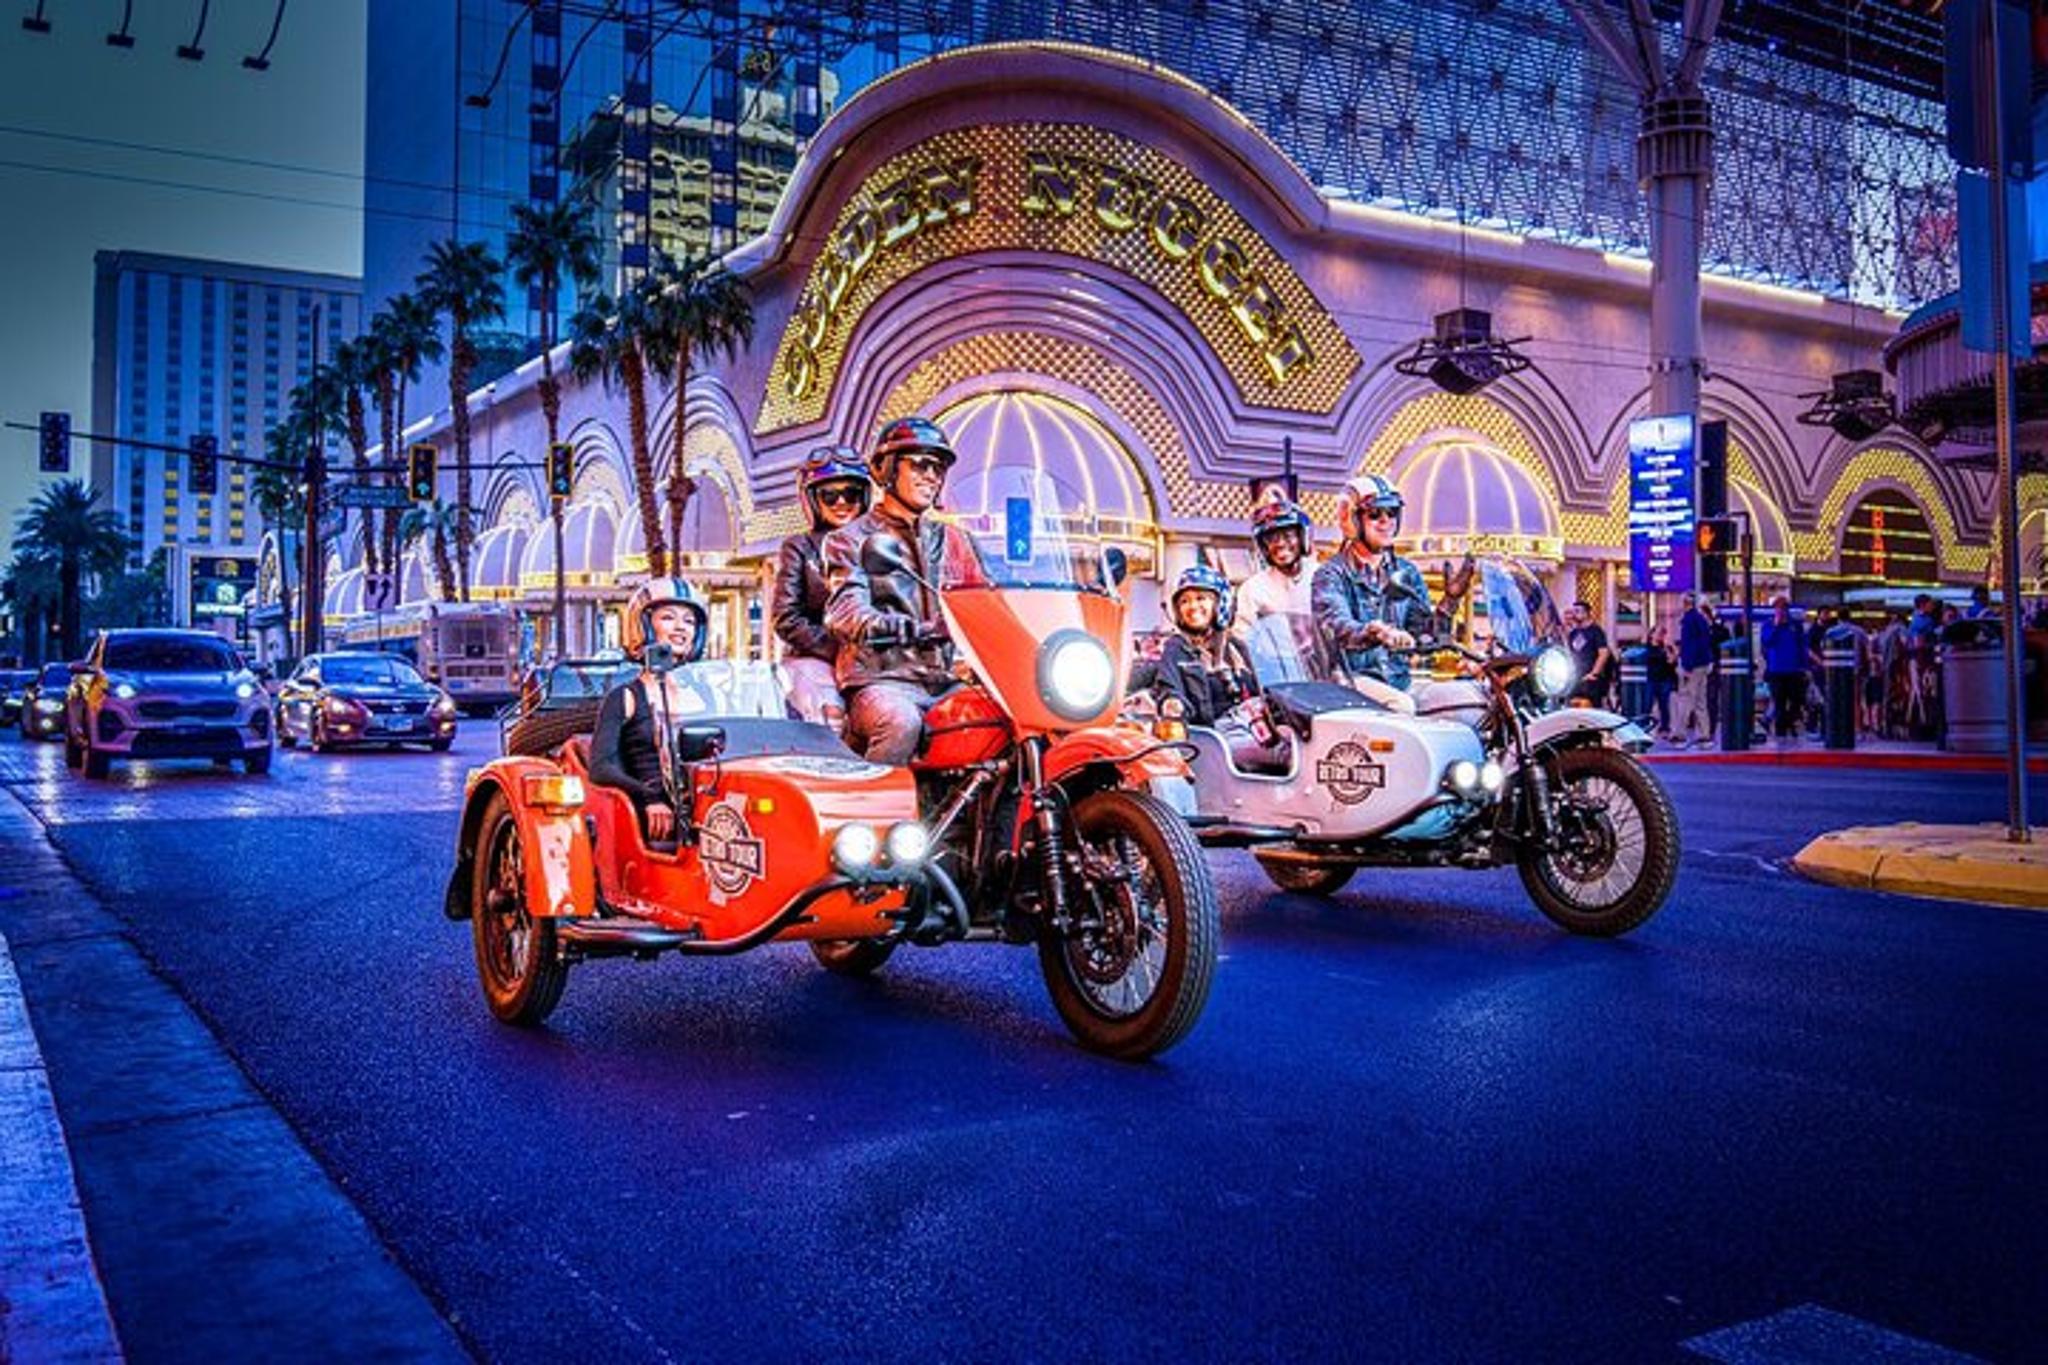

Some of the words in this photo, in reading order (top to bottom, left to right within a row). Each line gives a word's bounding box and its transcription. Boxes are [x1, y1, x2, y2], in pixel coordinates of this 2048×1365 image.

[784, 155, 978, 396] GOLDEN
[1022, 150, 1316, 383] NUGGET
[1354, 766, 1379, 785] TOUR
[729, 842, 758, 870] TOUR
